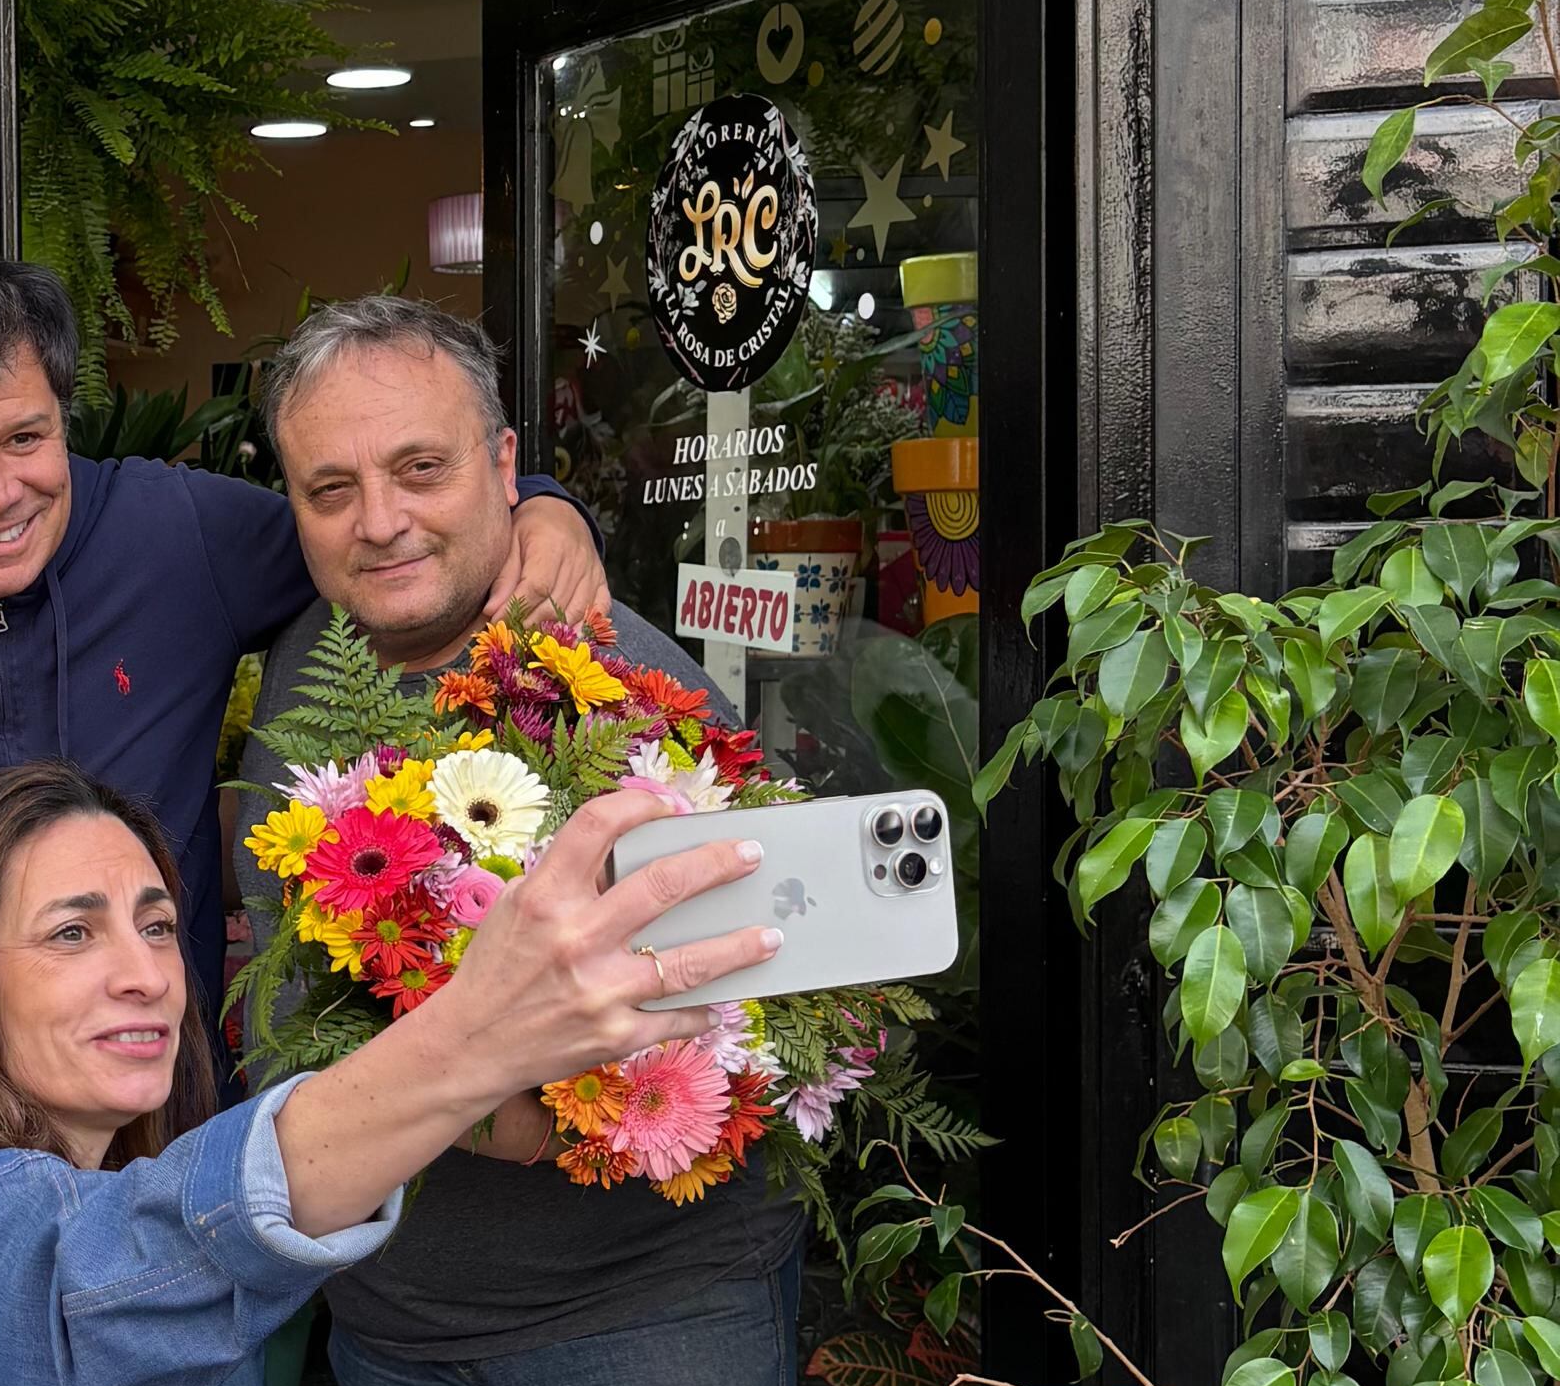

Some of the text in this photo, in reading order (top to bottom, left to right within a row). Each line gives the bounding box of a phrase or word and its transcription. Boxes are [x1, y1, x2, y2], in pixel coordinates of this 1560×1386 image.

[665, 286, 791, 368] LA ROSA DE CRISTAL
[672, 424, 786, 464] HORARIOS
[643, 462, 818, 504] LUNES A SABADOS
[680, 579, 789, 641] ABIERTO
